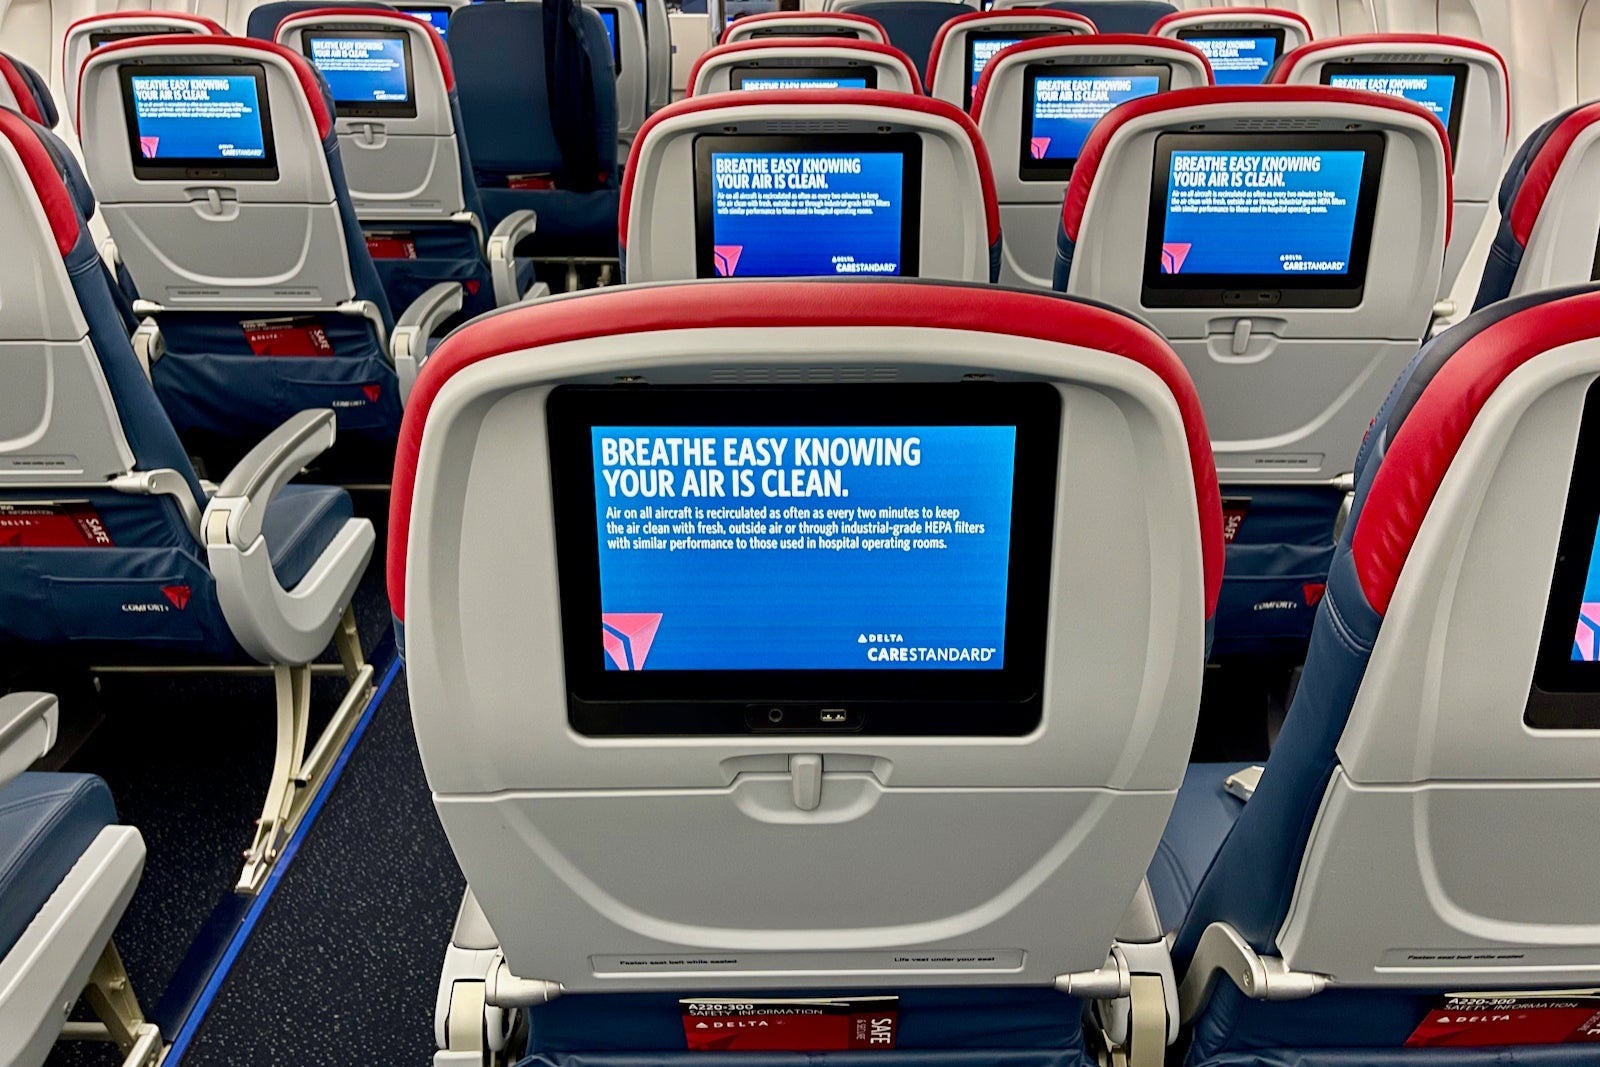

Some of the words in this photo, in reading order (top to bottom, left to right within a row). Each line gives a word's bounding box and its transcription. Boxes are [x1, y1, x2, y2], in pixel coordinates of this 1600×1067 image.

[134, 80, 170, 90] BREATHE
[169, 79, 190, 90] EASY
[190, 79, 229, 90] KNOWING
[1037, 80, 1072, 90] BREATHE
[1072, 80, 1092, 90] EASY
[1095, 80, 1131, 91] KNOWING
[1368, 79, 1388, 89] EASY
[1389, 79, 1427, 89] KNOWING
[135, 90, 159, 100] YOUR
[158, 90, 173, 100] AIR
[173, 90, 182, 100] IS
[182, 90, 210, 100] CLEAN.
[1037, 91, 1059, 101] YOUR
[1059, 91, 1072, 101] AIR
[1074, 91, 1082, 101] IS
[1083, 91, 1109, 101] CLEAN.
[716, 158, 768, 173] BREATHE
[771, 158, 801, 173] EASY
[803, 158, 860, 173] KNOWING
[1174, 156, 1228, 171] BREATHE
[1229, 156, 1260, 171] EASY
[1261, 156, 1321, 171] KNOWING
[716, 174, 749, 189] YOUR
[751, 174, 772, 189] AIR
[774, 174, 786, 189] IS
[788, 174, 828, 189] CLEAN.
[1172, 172, 1207, 186] YOUR
[1207, 172, 1230, 187] AIR
[1231, 172, 1243, 187] IS
[1244, 172, 1286, 187] CLEAN.
[836, 264, 896, 272] CARESTANDARD
[1283, 262, 1344, 271] CARESTANDARD
[601, 437, 716, 466] BREATHE
[723, 437, 788, 466] EASY
[795, 437, 921, 466] KNOWING
[602, 468, 675, 497] YOUR
[680, 468, 725, 497] AIR
[732, 468, 755, 497] IS
[761, 468, 848, 497] CLEAN.
[605, 506, 621, 519] Air
[623, 509, 637, 519] on
[639, 506, 652, 519] all
[654, 506, 692, 519] aircraft
[695, 506, 704, 519] is
[706, 506, 766, 519] recirculated
[769, 509, 781, 519] as
[783, 506, 810, 519] often
[812, 509, 824, 519] as
[826, 509, 854, 522] every
[856, 506, 876, 519] two
[878, 506, 919, 519] minutes
[921, 506, 933, 519] to
[935, 506, 960, 521] keep
[86, 518, 109, 543] SAFE
[606, 521, 624, 534] the
[625, 521, 640, 534] air
[642, 521, 670, 534] clean
[672, 521, 695, 534] with
[697, 521, 726, 535] fresh,
[728, 521, 766, 534] outside
[768, 521, 782, 534] air
[784, 524, 796, 534] or
[798, 521, 838, 537] through
[841, 521, 922, 536] industrial-grade
[924, 521, 952, 534] HEPA
[954, 521, 985, 534] filters
[607, 536, 630, 549] with
[632, 536, 667, 549] similar
[669, 536, 734, 551] performance
[735, 536, 747, 549] to
[749, 536, 777, 549] those
[780, 536, 804, 549] used
[806, 536, 816, 549] in
[818, 536, 859, 551] hospital
[861, 536, 910, 551] operating
[912, 539, 947, 549] rooms.
[868, 634, 903, 642] DELTA
[870, 1018, 892, 1044] SAFE
